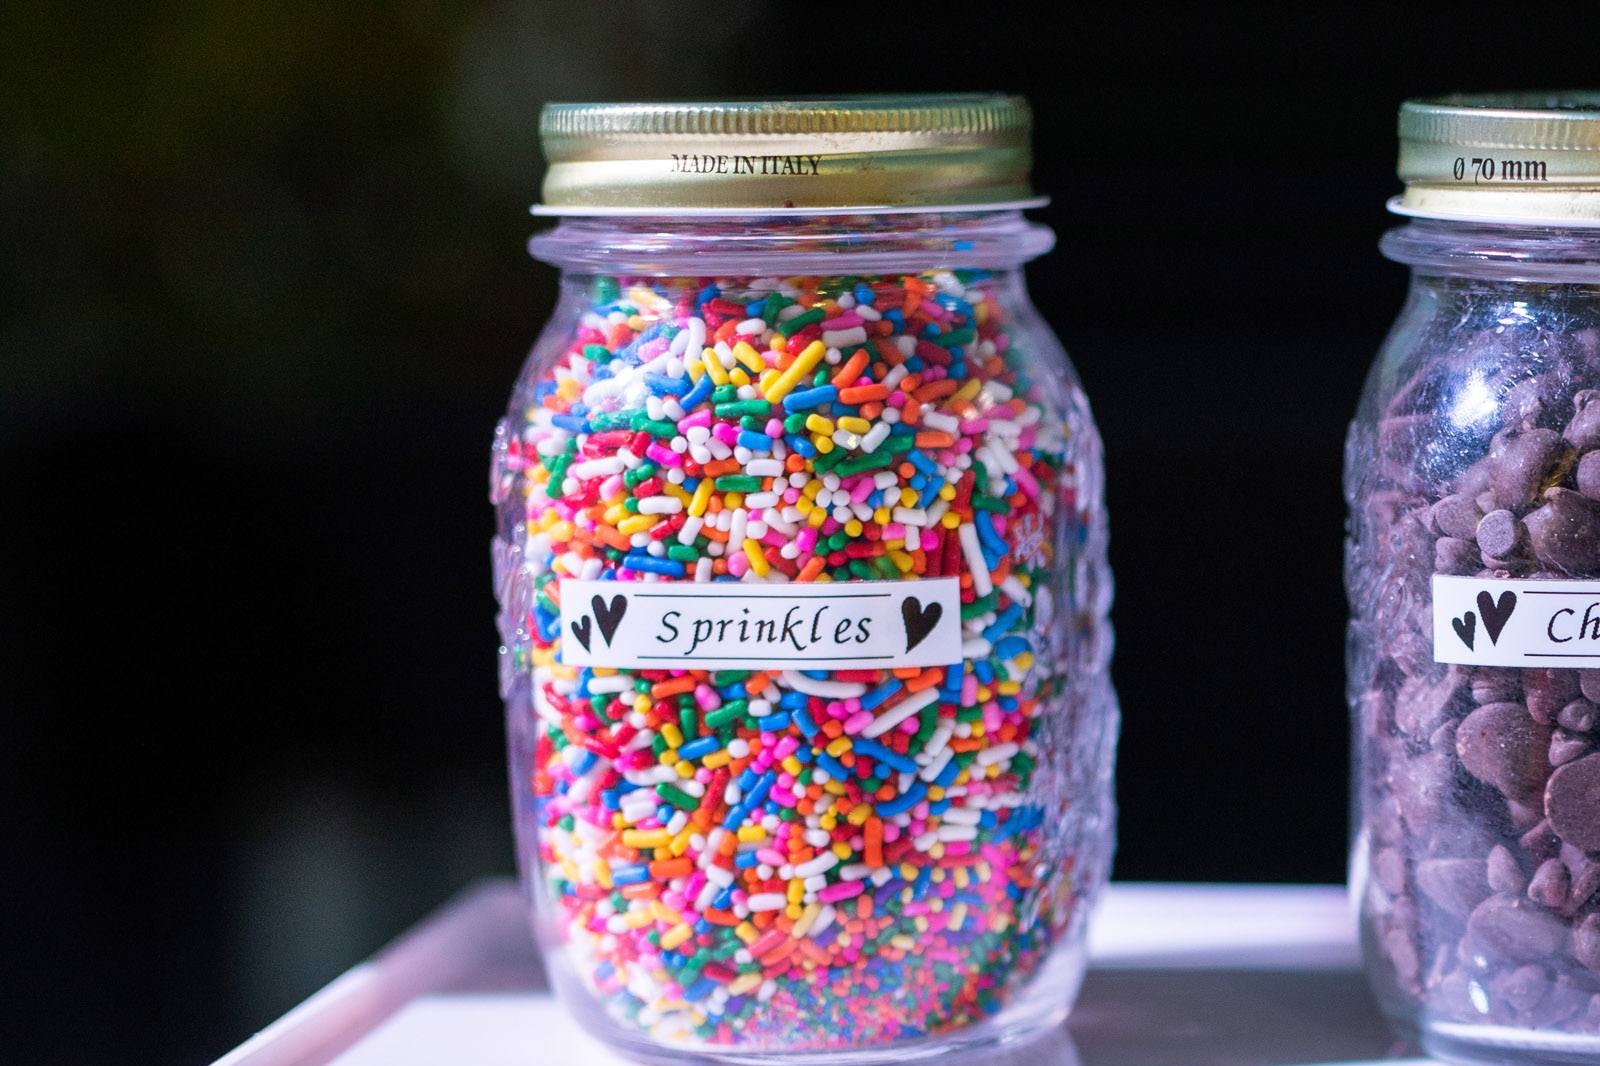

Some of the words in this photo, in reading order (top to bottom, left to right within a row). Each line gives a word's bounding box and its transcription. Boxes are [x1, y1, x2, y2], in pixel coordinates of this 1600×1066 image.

[671, 154, 729, 174] MADE
[732, 155, 754, 175] IN
[760, 154, 822, 175] ITALY
[1471, 158, 1495, 185] 70
[1501, 160, 1548, 182] mm
[655, 605, 873, 655] Sprinkles
